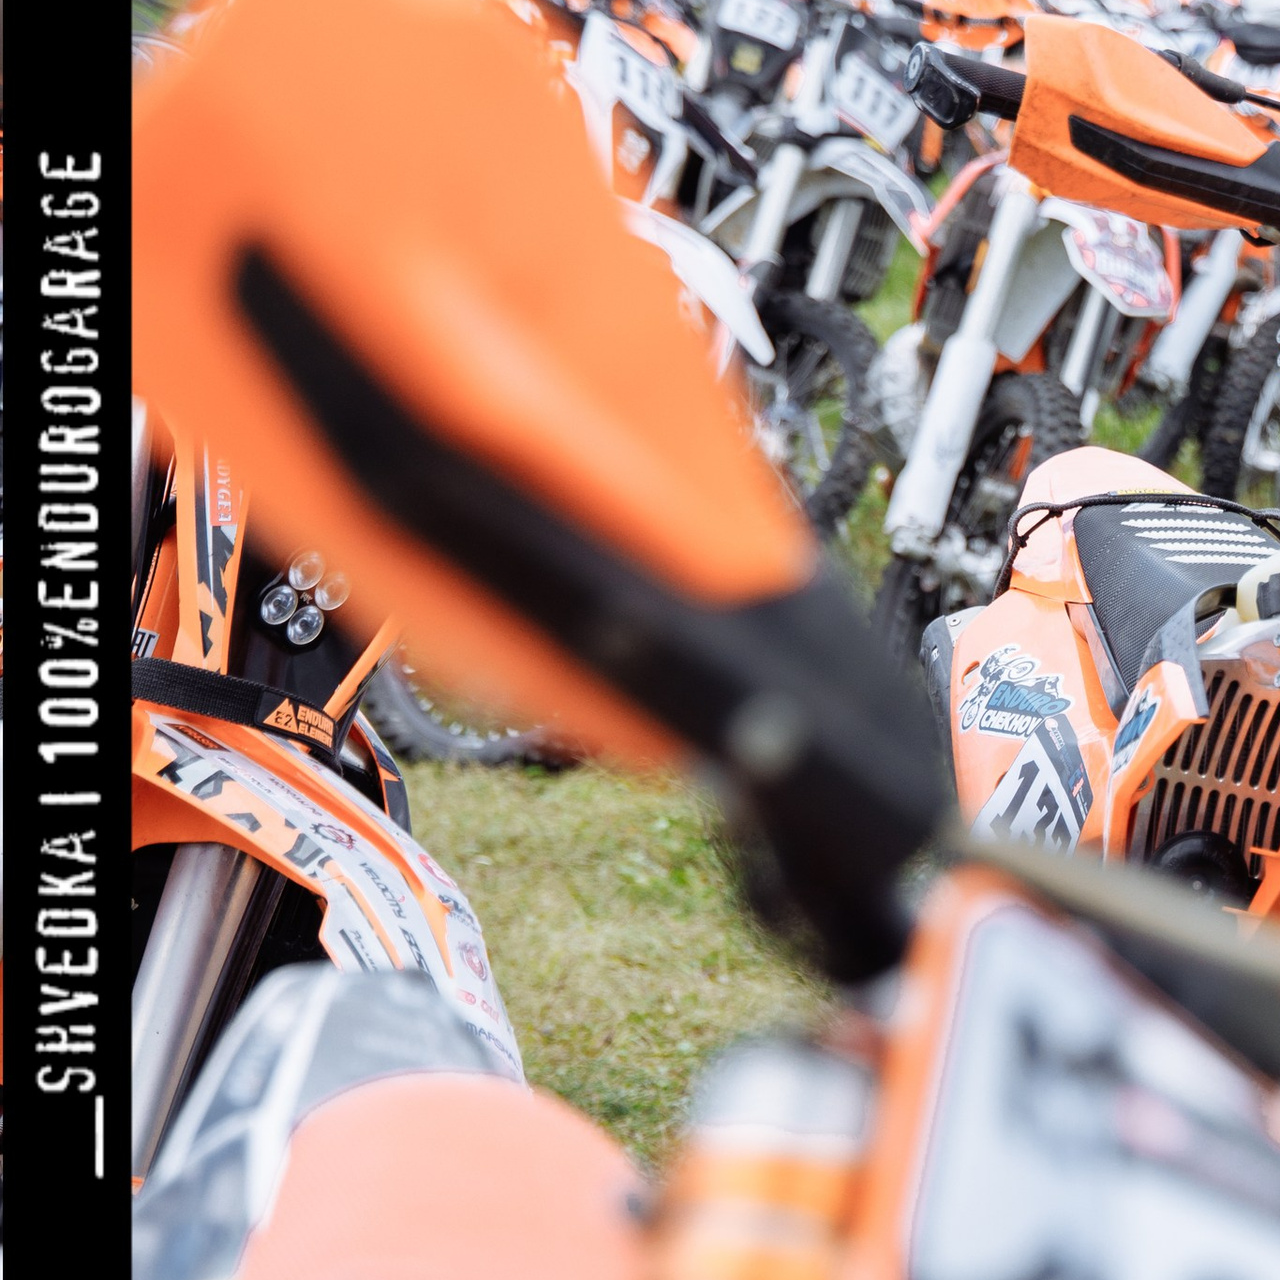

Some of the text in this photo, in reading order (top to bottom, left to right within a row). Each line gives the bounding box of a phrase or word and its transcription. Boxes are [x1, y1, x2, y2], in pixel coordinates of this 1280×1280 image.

[988, 684, 1065, 715] ENDURO
[297, 705, 334, 737] ENDURO
[981, 709, 1043, 738] CHEKHOV
[359, 862, 407, 920] VELOCITY
